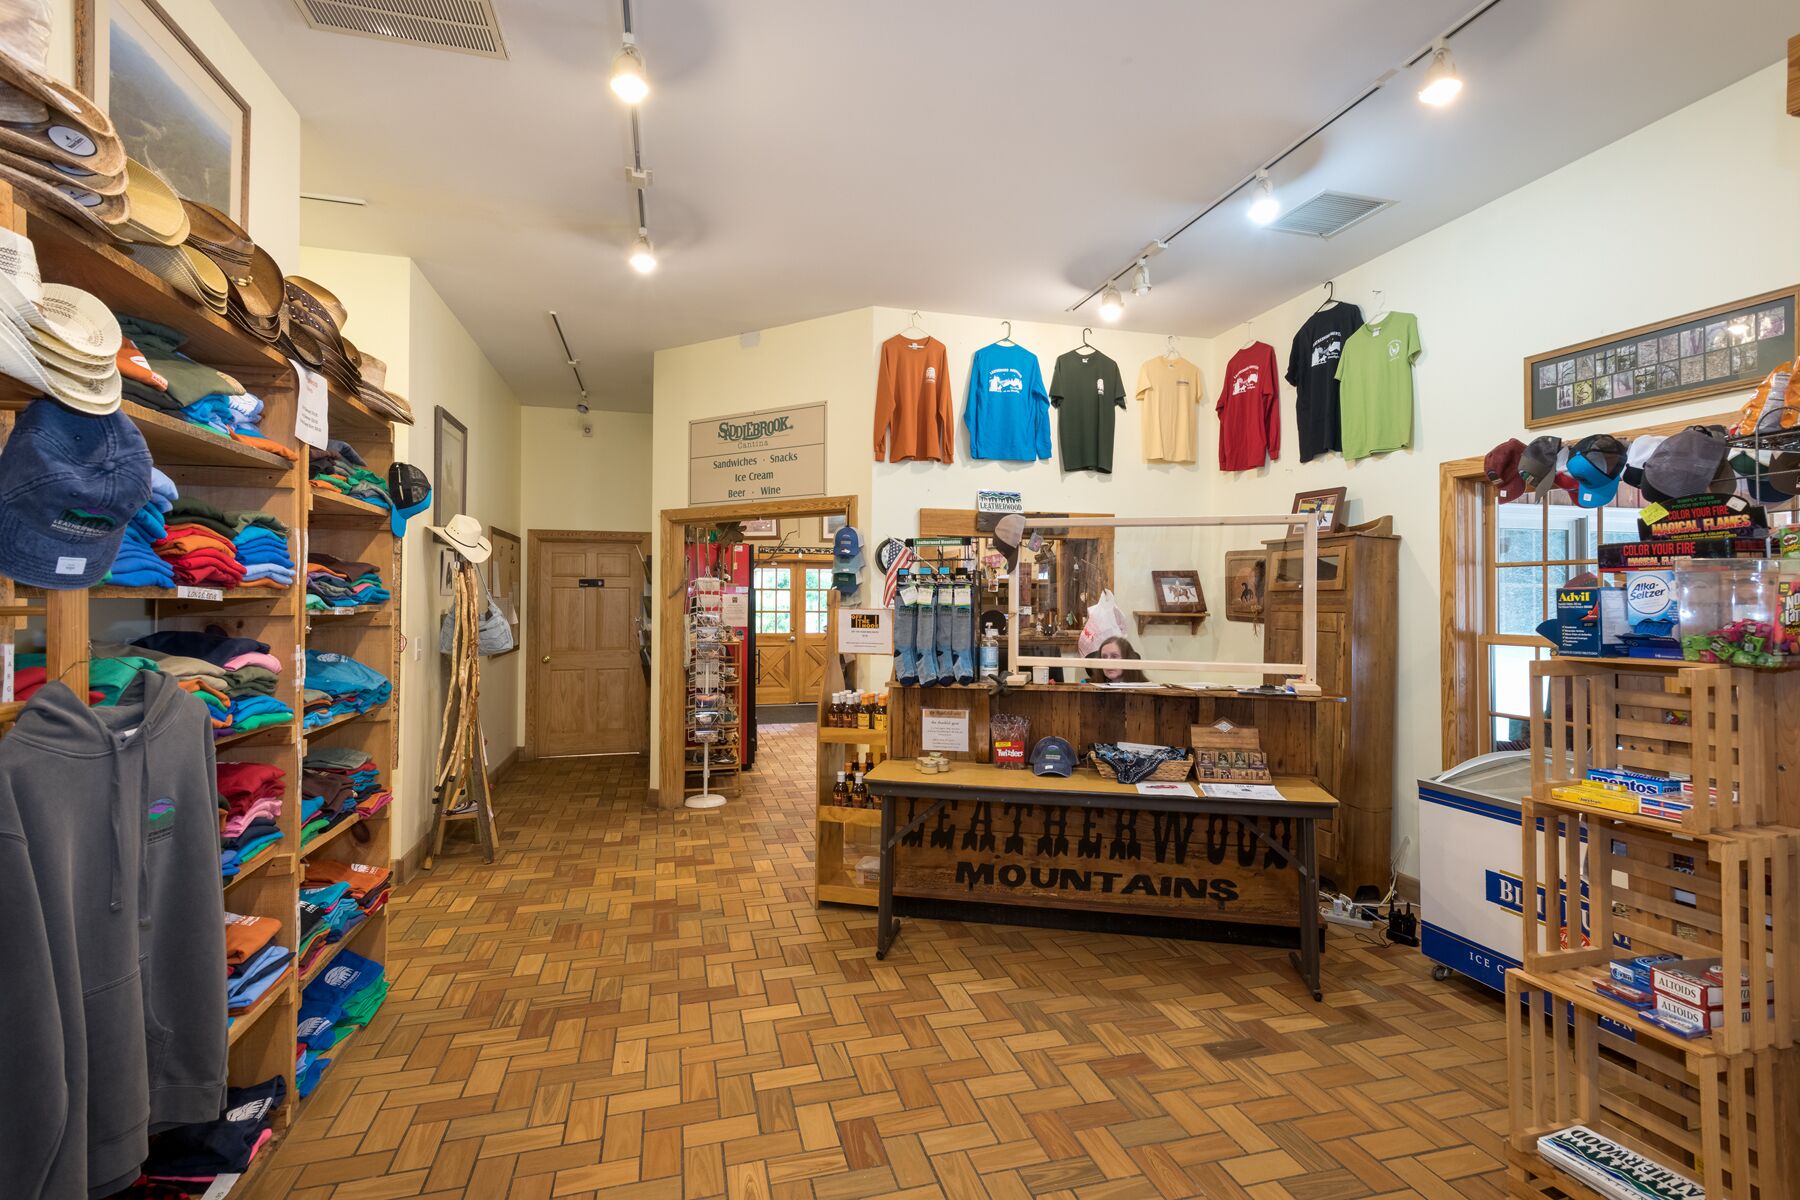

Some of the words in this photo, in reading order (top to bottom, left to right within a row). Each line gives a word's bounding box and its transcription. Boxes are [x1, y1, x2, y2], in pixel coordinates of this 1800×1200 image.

[737, 440, 768, 449] Cantina
[713, 457, 757, 469] Sandwiches
[770, 452, 798, 463] Snacks
[735, 473, 747, 482] Ice
[749, 470, 774, 482] Cream
[728, 489, 746, 498] Beer
[760, 486, 781, 496] Wine
[980, 502, 1022, 511] LEATHERWOOD
[1668, 508, 1690, 520] COLOR
[1691, 507, 1711, 518] YOUR
[1712, 505, 1729, 516] FIRE
[1651, 519, 1701, 536] MAGICAL
[1703, 514, 1751, 531] FLAMES
[1623, 545, 1650, 556] COLOR
[1651, 543, 1675, 555] YOUR
[1676, 542, 1696, 554] FIRE
[1633, 582, 1659, 592] Alka-
[1559, 592, 1590, 602] Advil
[1630, 588, 1666, 601] Seltzer
[955, 861, 1239, 901] MOUNTAINS
[1469, 951, 1490, 967] ICE
[1658, 977, 1697, 998] ALTOIDS
[1662, 1001, 1699, 1023] ALTOIDS
[1571, 1129, 1705, 1197] ATHERWOOD
